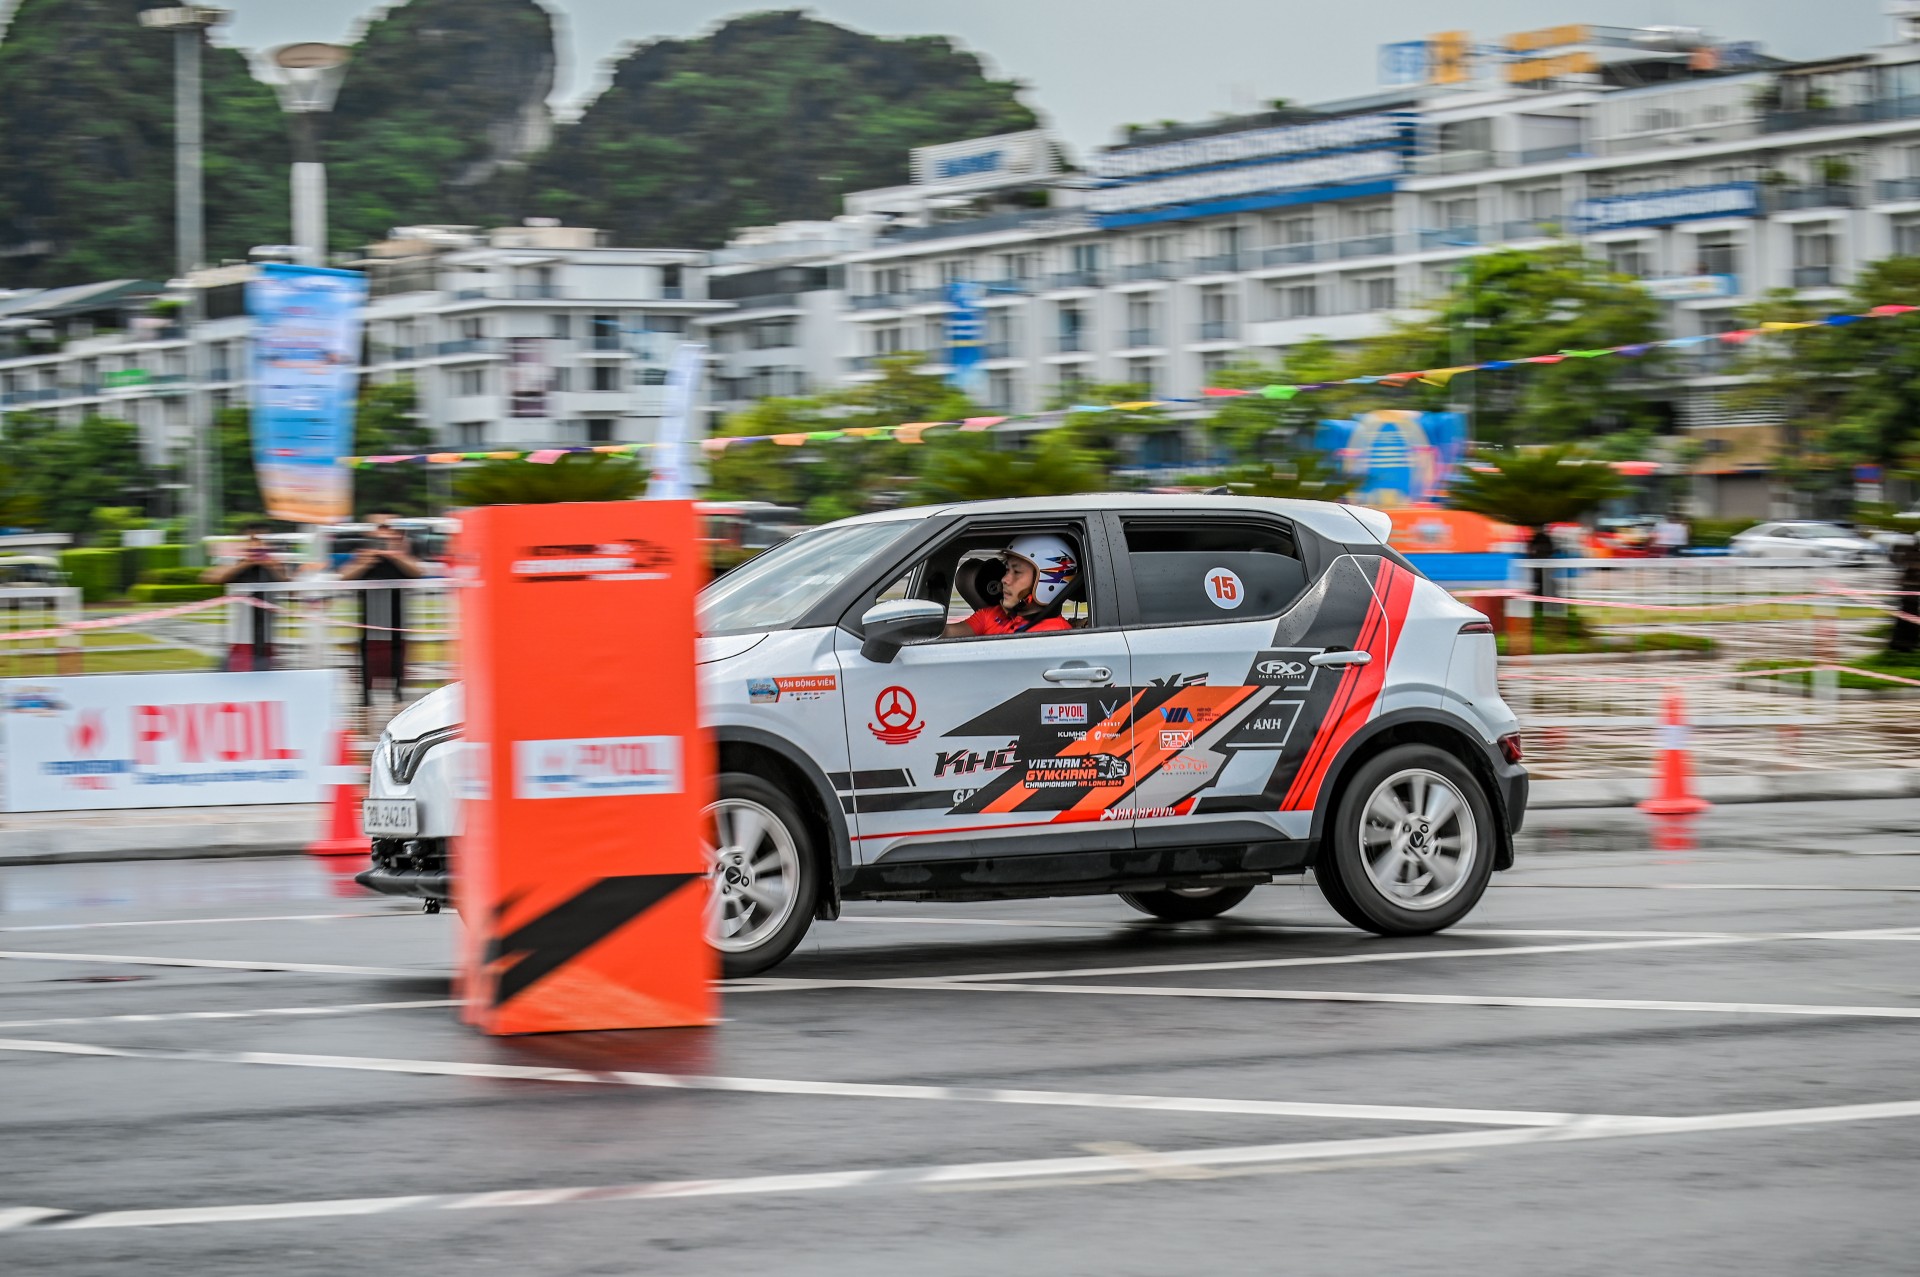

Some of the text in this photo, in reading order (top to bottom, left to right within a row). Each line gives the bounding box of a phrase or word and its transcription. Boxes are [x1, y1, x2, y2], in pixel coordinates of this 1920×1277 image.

[1210, 575, 1237, 600] 15
[778, 679, 794, 689] VẬN
[795, 679, 816, 689] ĐỘNG
[817, 678, 835, 687] VIÊN
[1058, 705, 1085, 718] PVOIL
[1253, 718, 1282, 731] ANH
[1057, 730, 1087, 738] KUMHO
[1162, 740, 1194, 748] MEDIA
[1028, 758, 1081, 769] VIETNAM
[1025, 769, 1097, 781] GYMKHANA
[1025, 781, 1077, 789] CHAMPIONSHIP
